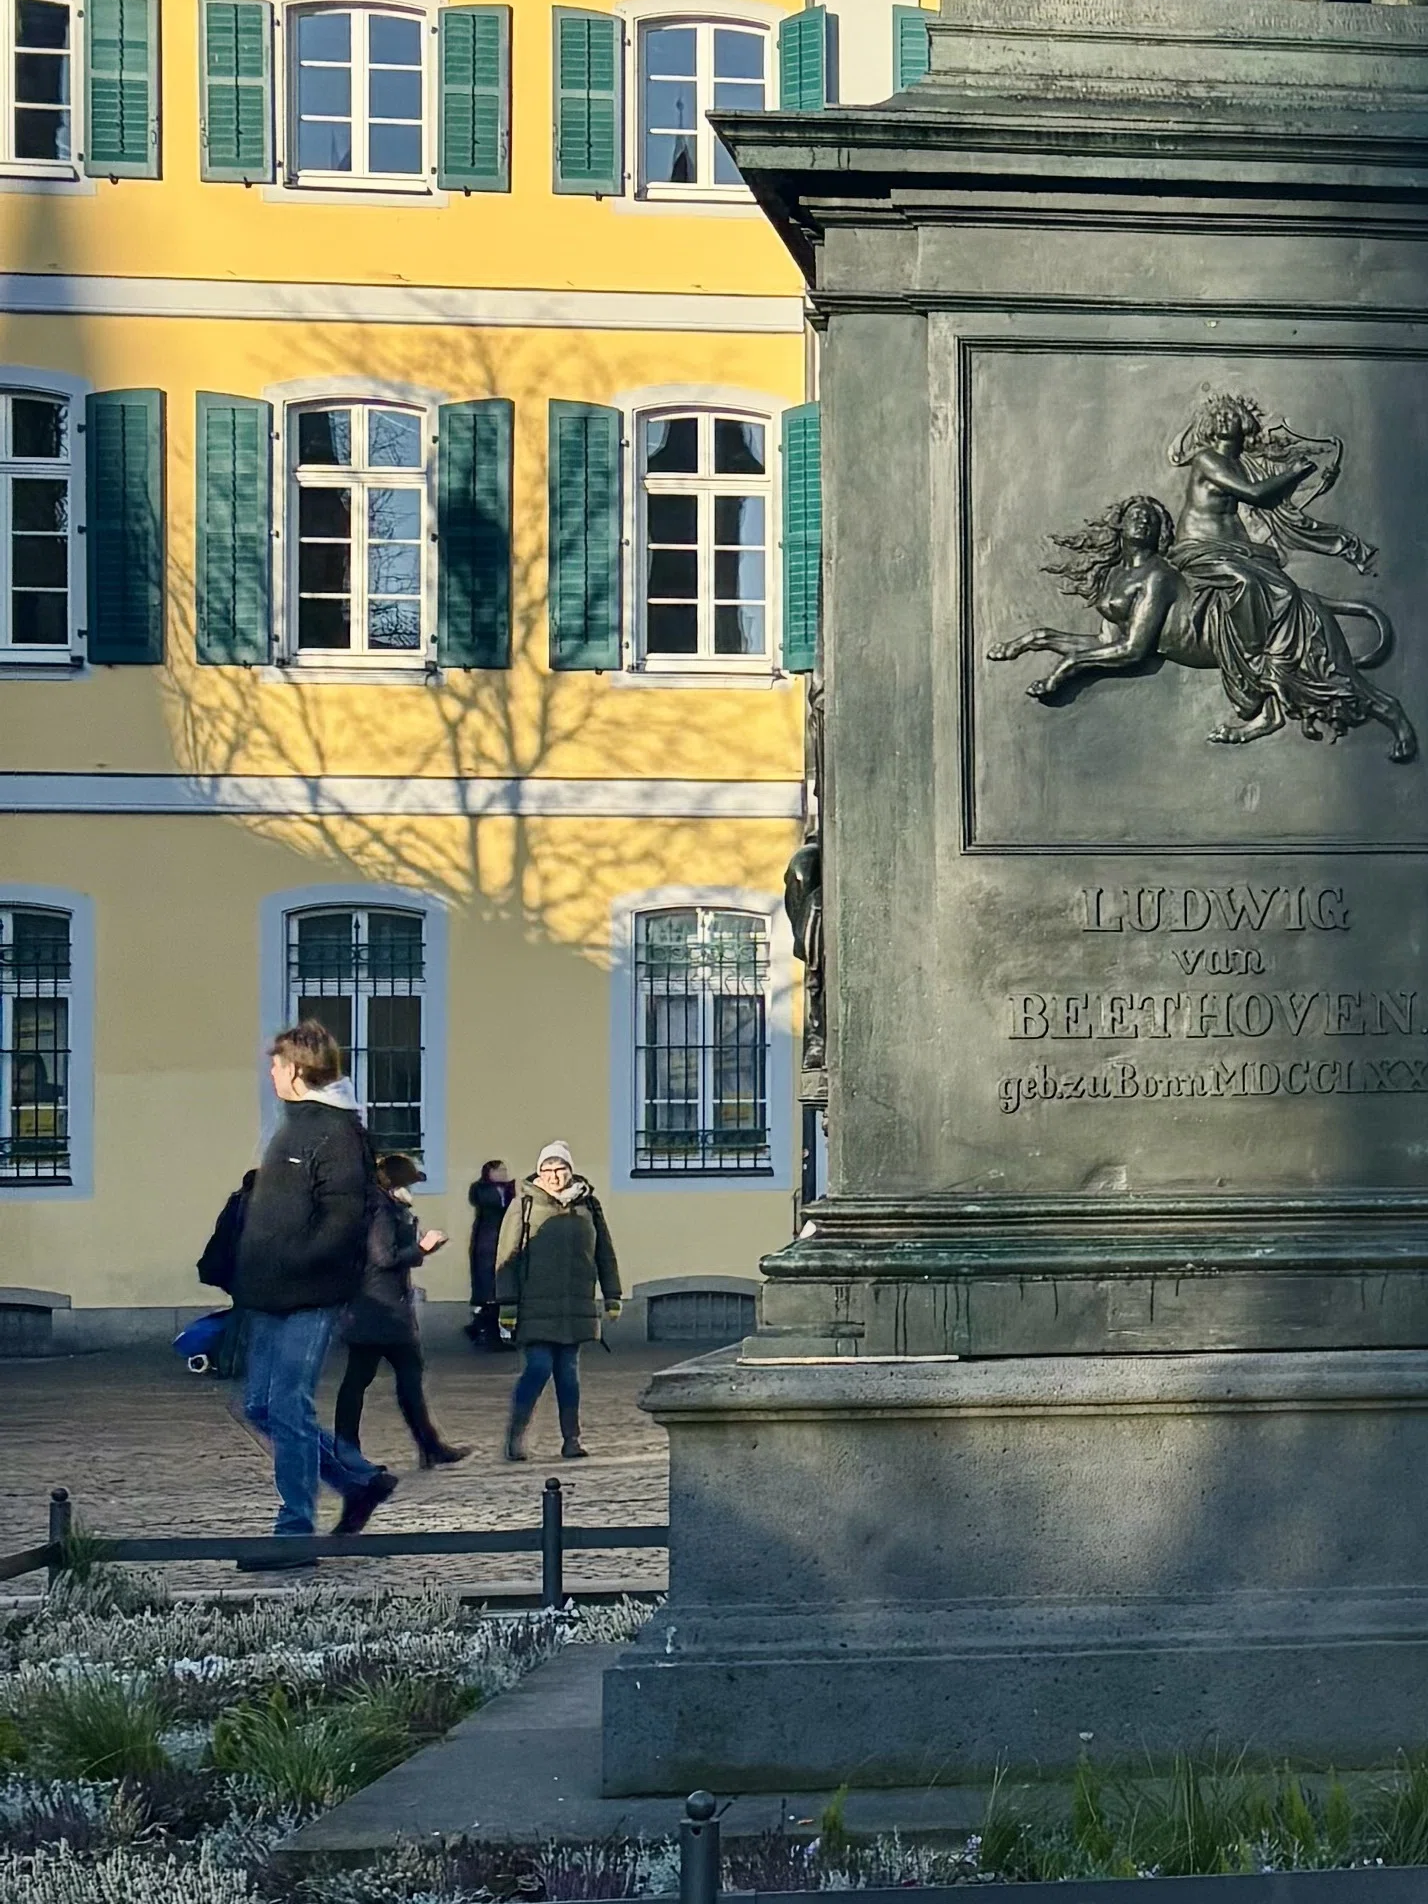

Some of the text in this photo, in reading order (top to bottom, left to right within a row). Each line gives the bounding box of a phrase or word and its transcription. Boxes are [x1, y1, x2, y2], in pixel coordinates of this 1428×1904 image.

[1081, 887, 1350, 932] LUDWIG
[1171, 946, 1267, 975] van
[1111, 1062, 1208, 1098] Bonn
